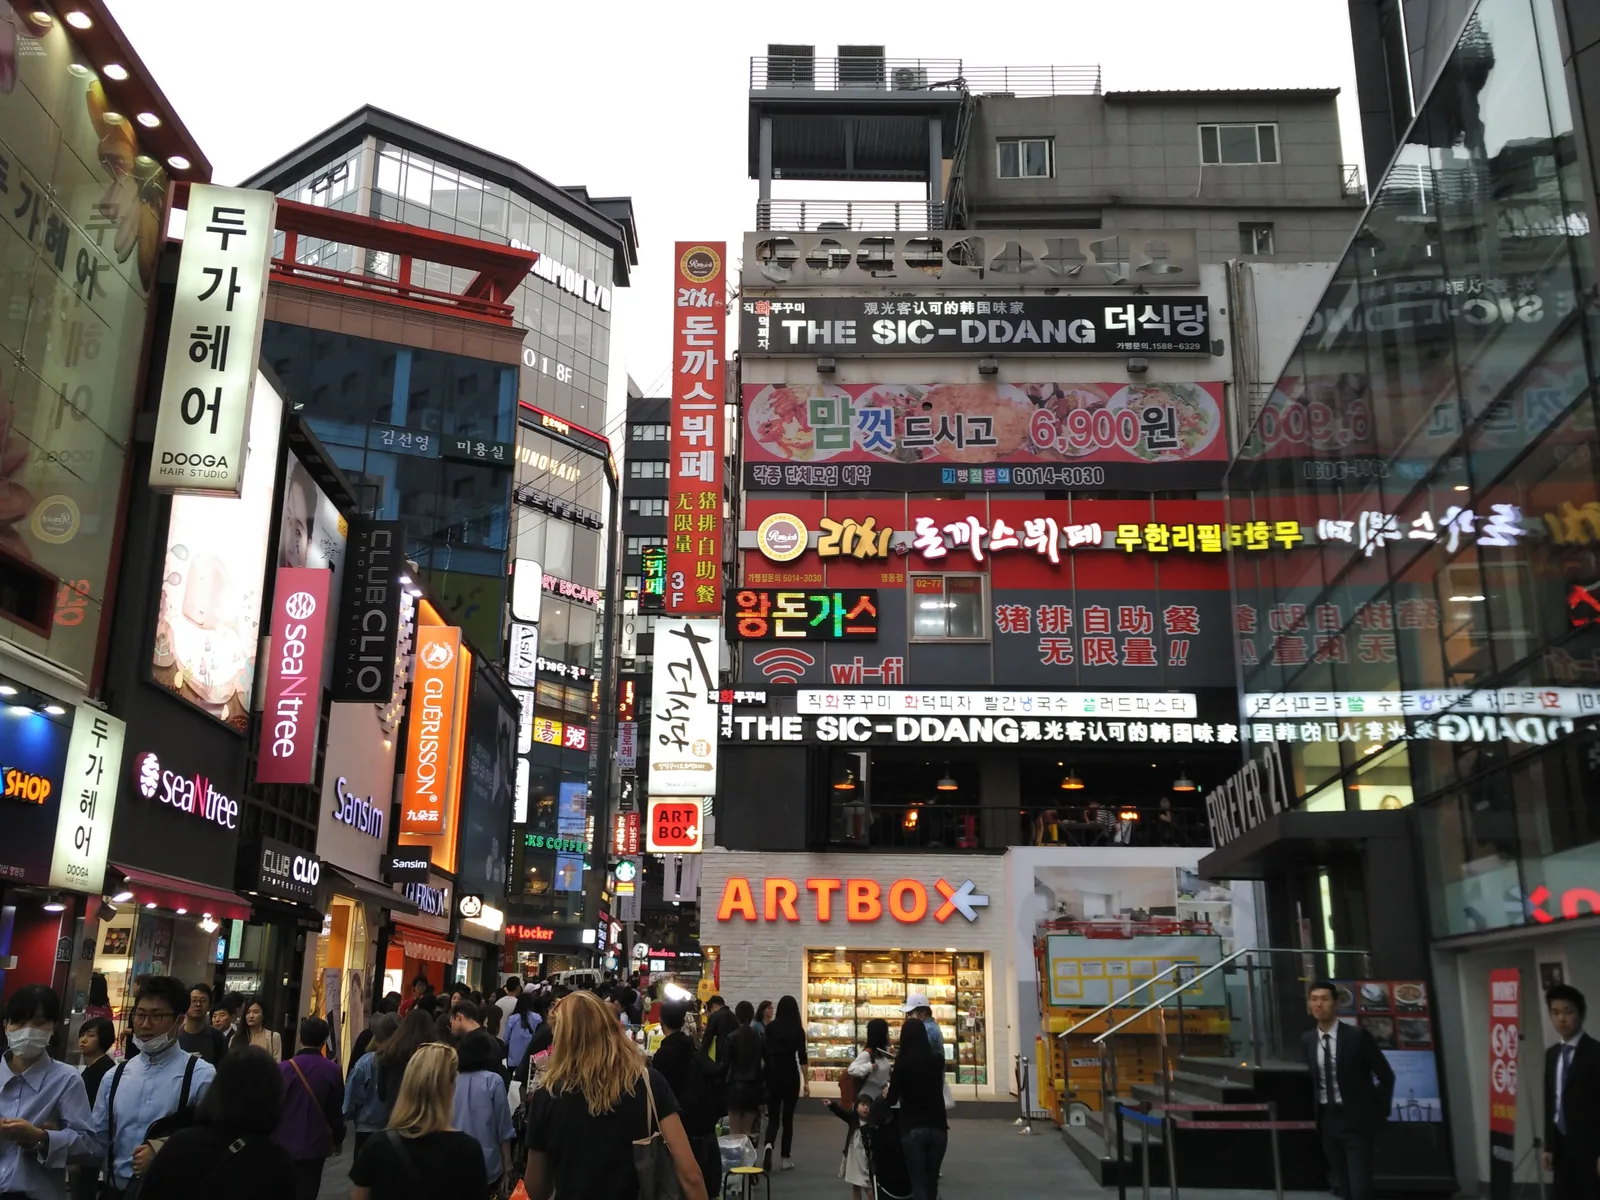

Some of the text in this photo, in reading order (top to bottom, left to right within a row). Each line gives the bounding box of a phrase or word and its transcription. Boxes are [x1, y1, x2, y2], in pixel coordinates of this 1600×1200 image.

[585, 278, 611, 313] B/D
[677, 288, 715, 308] 리치
[744, 301, 805, 316] 직화쭈꾸미
[181, 205, 247, 434] 두가헤어
[782, 319, 1097, 345] THE SIC-DDANG
[1105, 304, 1208, 336] 더식당
[680, 316, 719, 483] 돈까스뷔페
[808, 397, 897, 453] 맘껏
[902, 413, 998, 451] 드시고
[381, 429, 503, 459] 김선영 미용실
[160, 451, 228, 468] DOOGA
[160, 467, 228, 479] HAIR STUDIO
[843, 466, 871, 485] 예약
[1013, 467, 1104, 485] 6014-3030
[674, 493, 695, 554] 无限量
[818, 516, 893, 559] 리치
[1117, 522, 1223, 553] 무한리필
[696, 491, 718, 605] 猪排自助餐
[560, 579, 601, 605] ESCAPE
[735, 591, 877, 637] 왕돈가스
[996, 604, 1199, 635] 猪排自助餐
[831, 656, 904, 684] wi-fi
[272, 623, 308, 758] seaNtree
[808, 694, 1187, 713] 직화쭈꾸미 화덕피자 빨간냉국수 샐러드파스타
[735, 716, 1019, 744] THE SIC-DDANG
[5, 769, 51, 805] SHOP
[75, 717, 109, 857] 두가헤어
[1264, 740, 1289, 816] 21
[159, 769, 239, 830] seaNtree
[333, 776, 384, 841] Sansim
[406, 809, 439, 822] 九朵云
[659, 811, 693, 828] ART
[546, 838, 588, 854] COFFEE
[659, 827, 697, 844] BOX
[66, 864, 89, 878] DOOGA
[263, 849, 320, 886] CLUB CLIO
[392, 859, 428, 870] Sansim
[717, 877, 986, 923] ARTBOX
[518, 925, 555, 942] Locker
